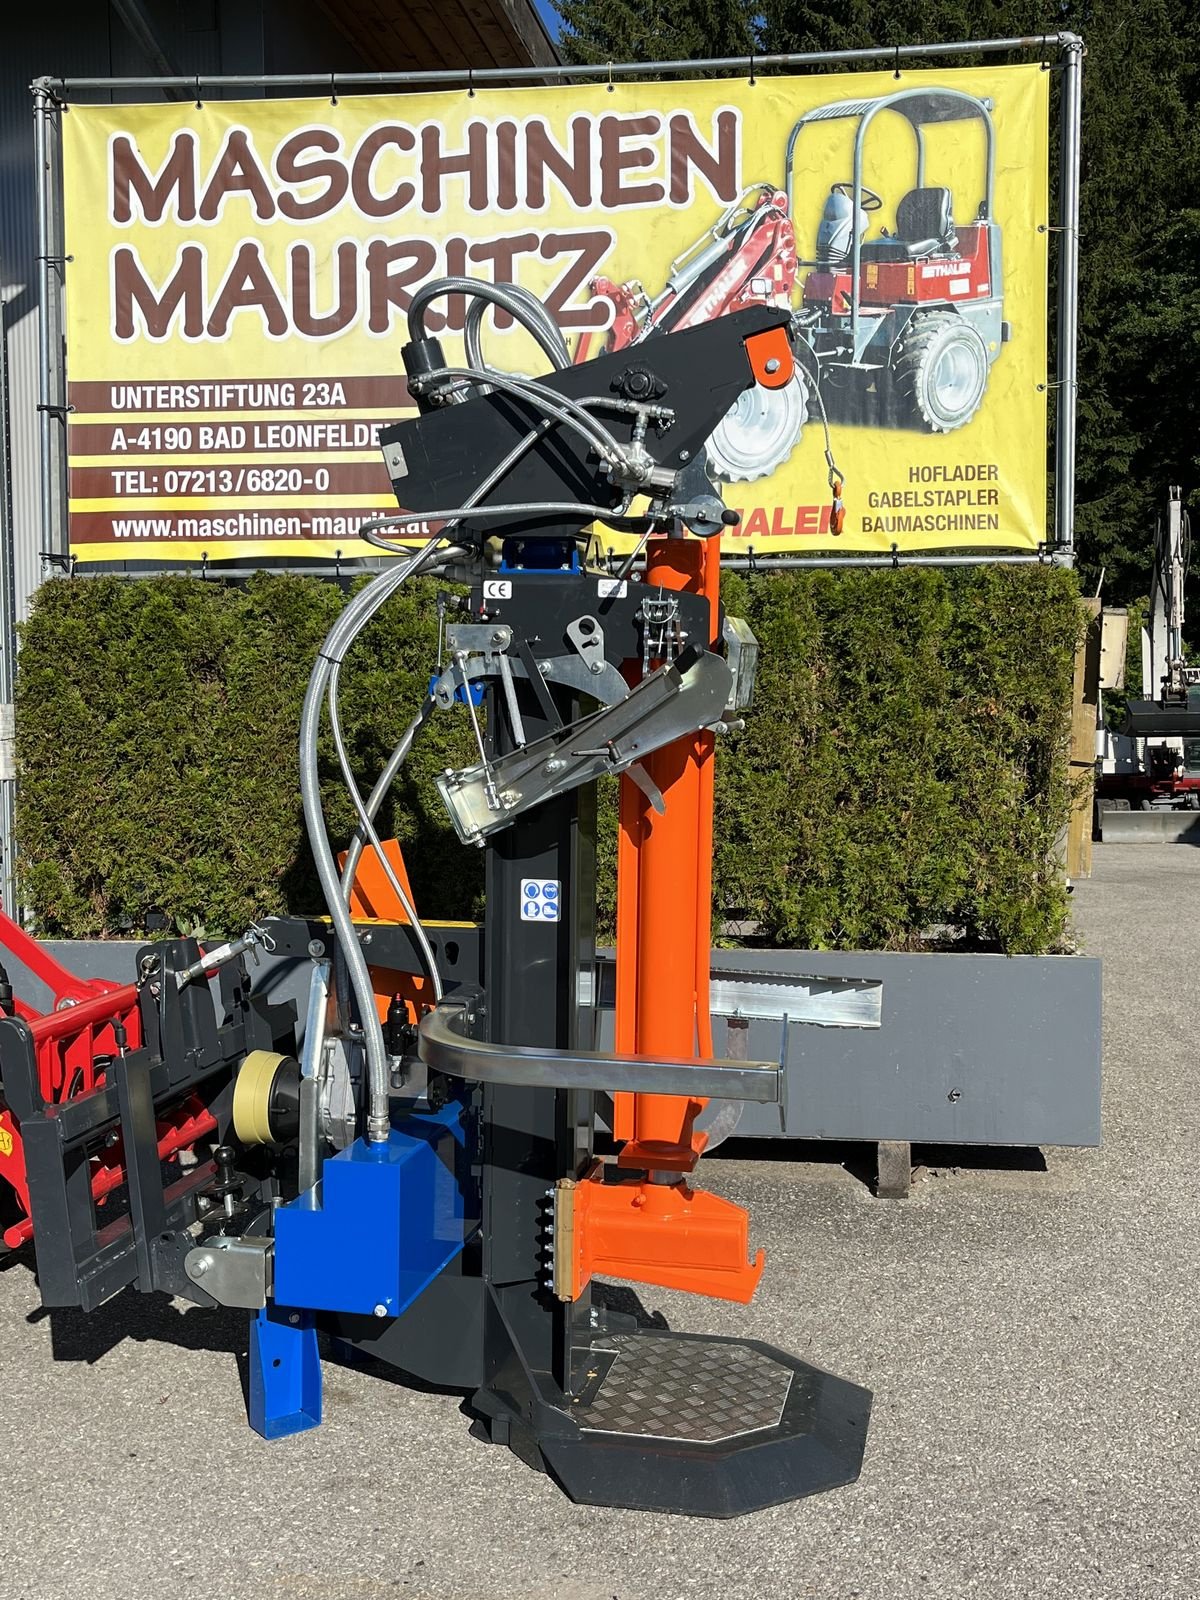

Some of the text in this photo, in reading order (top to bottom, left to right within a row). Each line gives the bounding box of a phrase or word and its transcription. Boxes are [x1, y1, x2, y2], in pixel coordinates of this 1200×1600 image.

[112, 110, 738, 223] MASCHINEN
[114, 230, 613, 338] MAURITZ
[110, 382, 347, 409] UNTERSTIFTUNG 23A
[110, 422, 396, 450] A-4190 BAD LEONFELDE
[111, 468, 330, 494] TEL: 07213/6820-0
[909, 464, 999, 482] HOFLADER
[868, 489, 999, 508] GABELSTAPLER
[861, 514, 999, 533] BAUMASCHINEN
